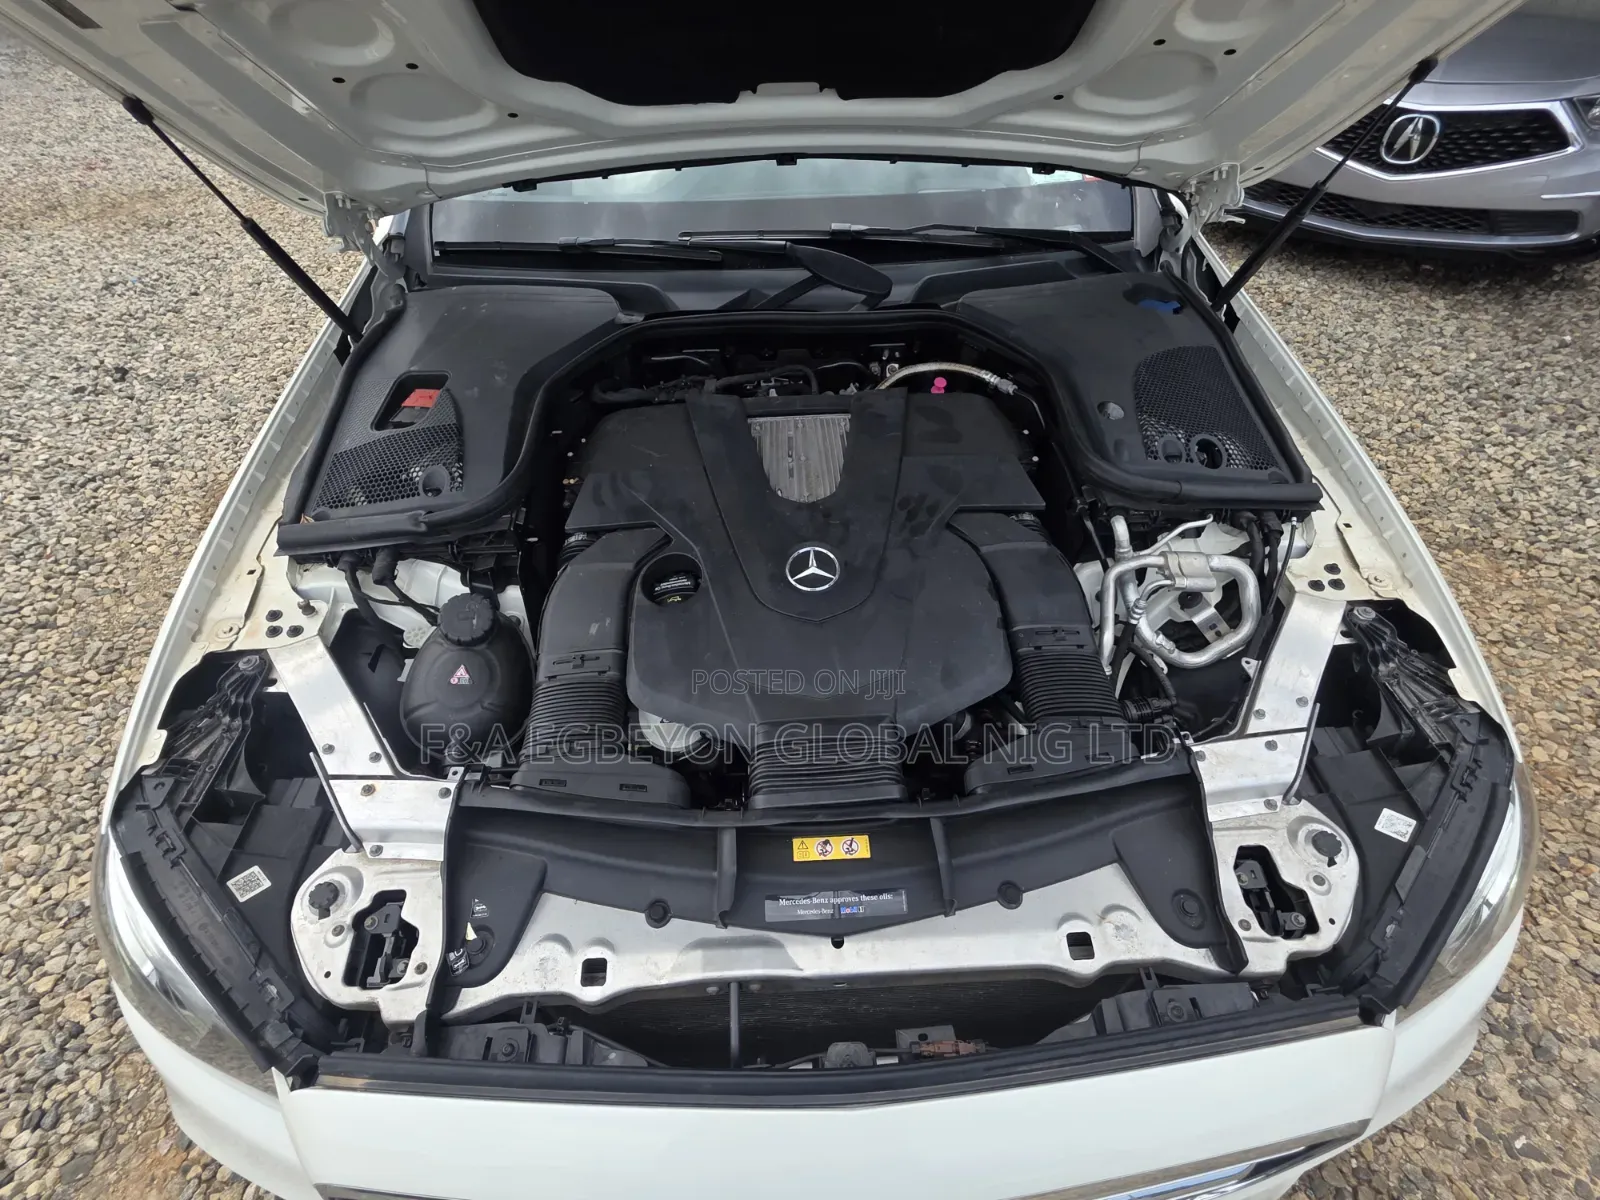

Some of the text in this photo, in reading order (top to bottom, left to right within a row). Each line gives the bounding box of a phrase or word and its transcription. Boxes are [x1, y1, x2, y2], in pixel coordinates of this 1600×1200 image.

[779, 897, 829, 906] Mercedes-Benz
[830, 896, 859, 904] approves
[860, 894, 878, 902] these
